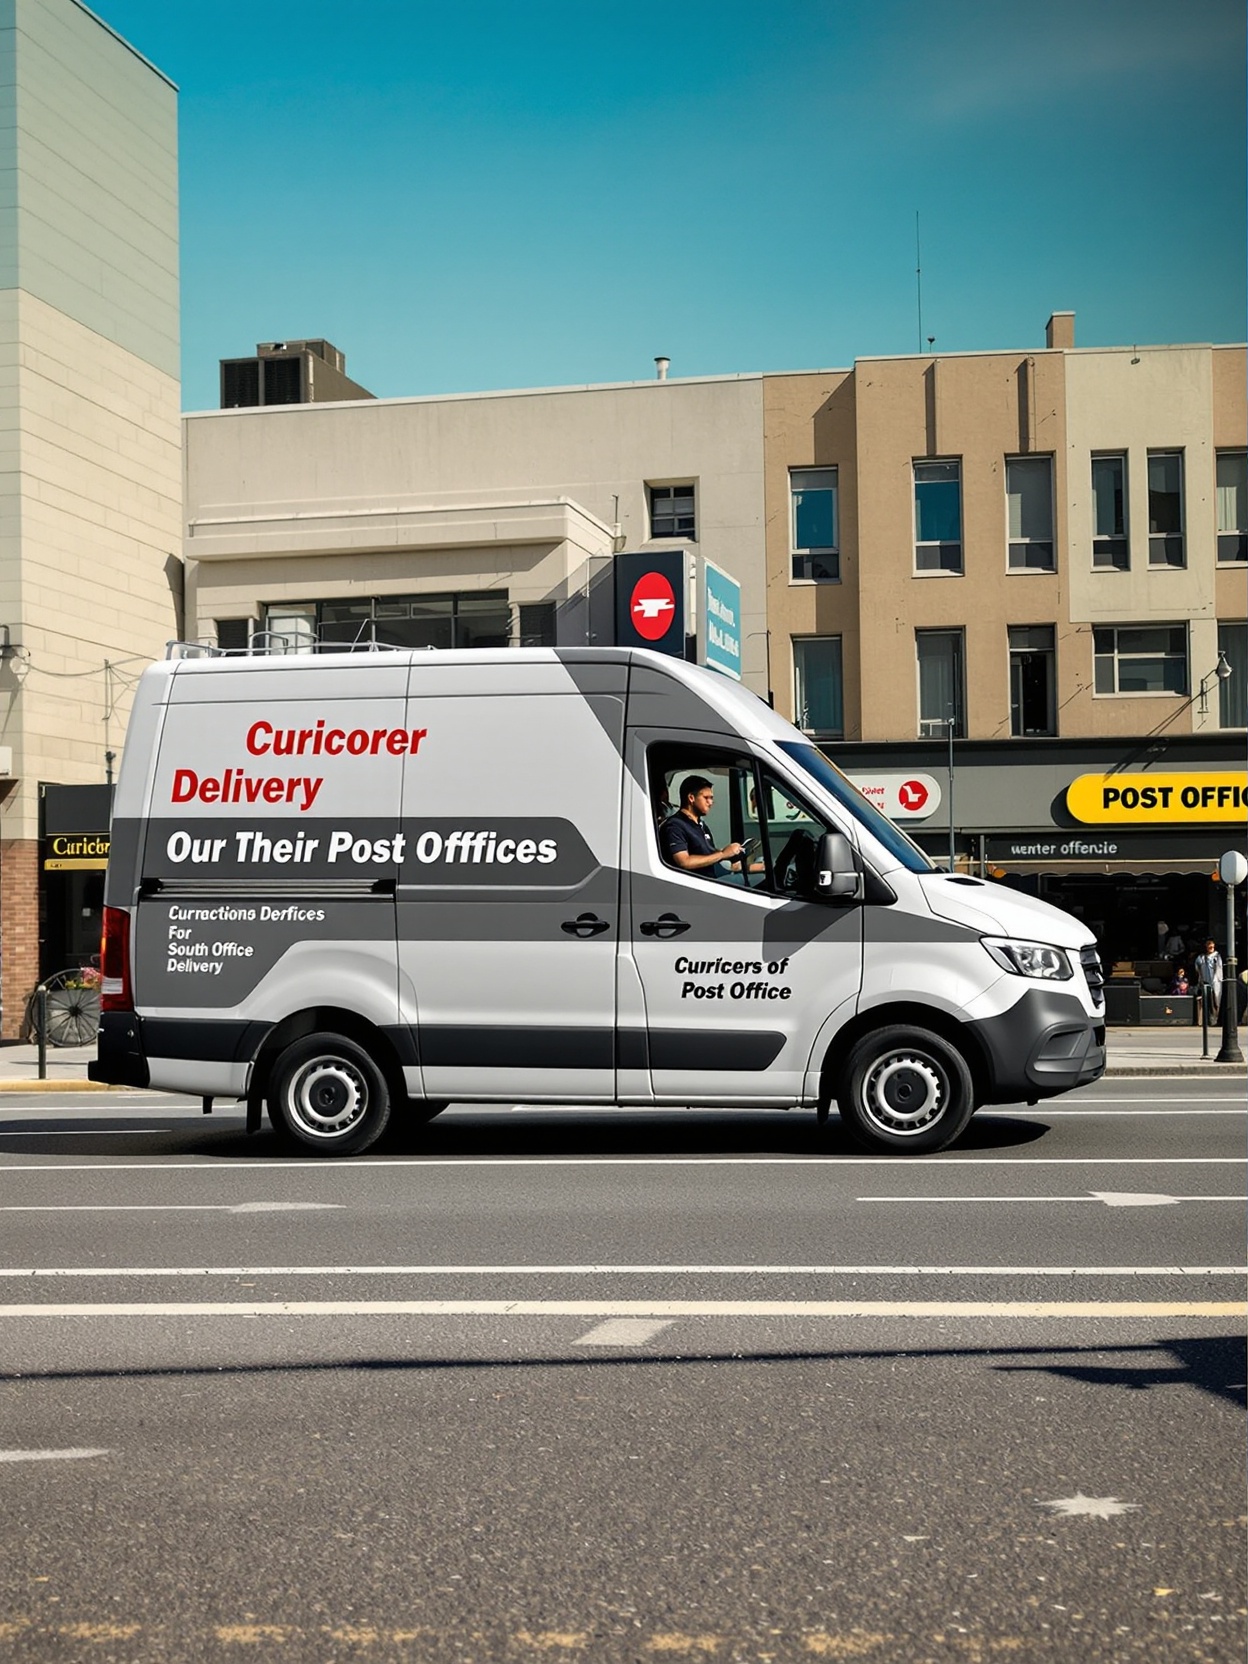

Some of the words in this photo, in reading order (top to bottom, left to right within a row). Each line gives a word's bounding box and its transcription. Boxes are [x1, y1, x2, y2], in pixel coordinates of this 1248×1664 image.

[246, 720, 427, 756] Curicorer
[171, 768, 323, 811] Delivery
[1103, 787, 1173, 809] POST
[166, 831, 226, 863] Our
[235, 831, 319, 863] Their
[327, 831, 406, 864] Post
[168, 925, 192, 940] For
[167, 942, 209, 956] South
[211, 941, 254, 957] Office
[166, 958, 224, 975] Delivery
[767, 957, 790, 975] of
[681, 981, 725, 999] Post
[729, 981, 792, 1000] Office
